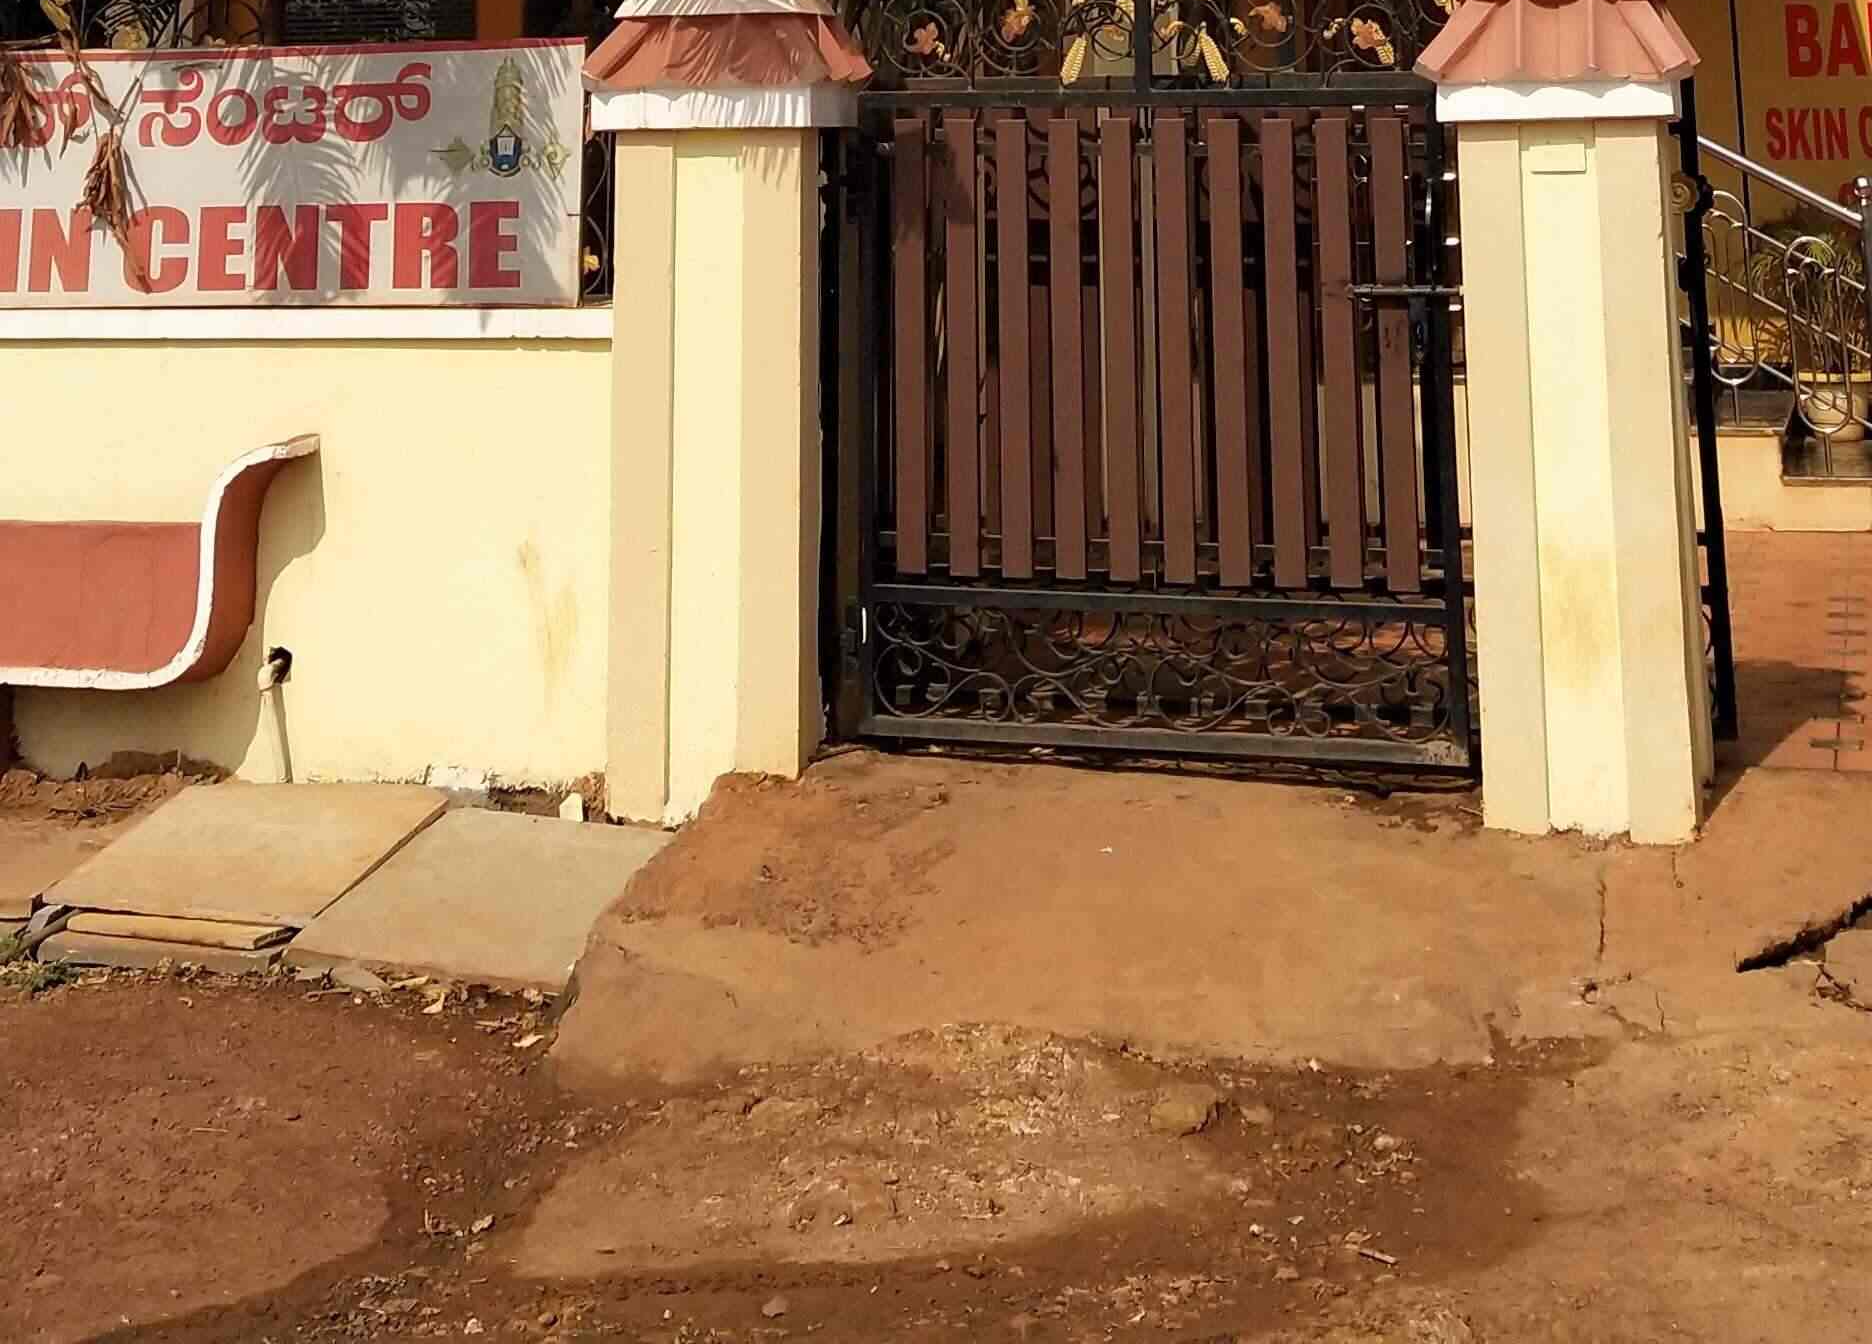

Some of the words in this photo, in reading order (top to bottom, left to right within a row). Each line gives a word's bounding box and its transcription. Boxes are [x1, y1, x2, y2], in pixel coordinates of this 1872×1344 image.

[1785, 2, 1872, 78] BA
[138, 63, 432, 147] ಸೆಂಟರ್
[1766, 107, 1849, 160] SKIN
[123, 200, 521, 294] CENTRE
